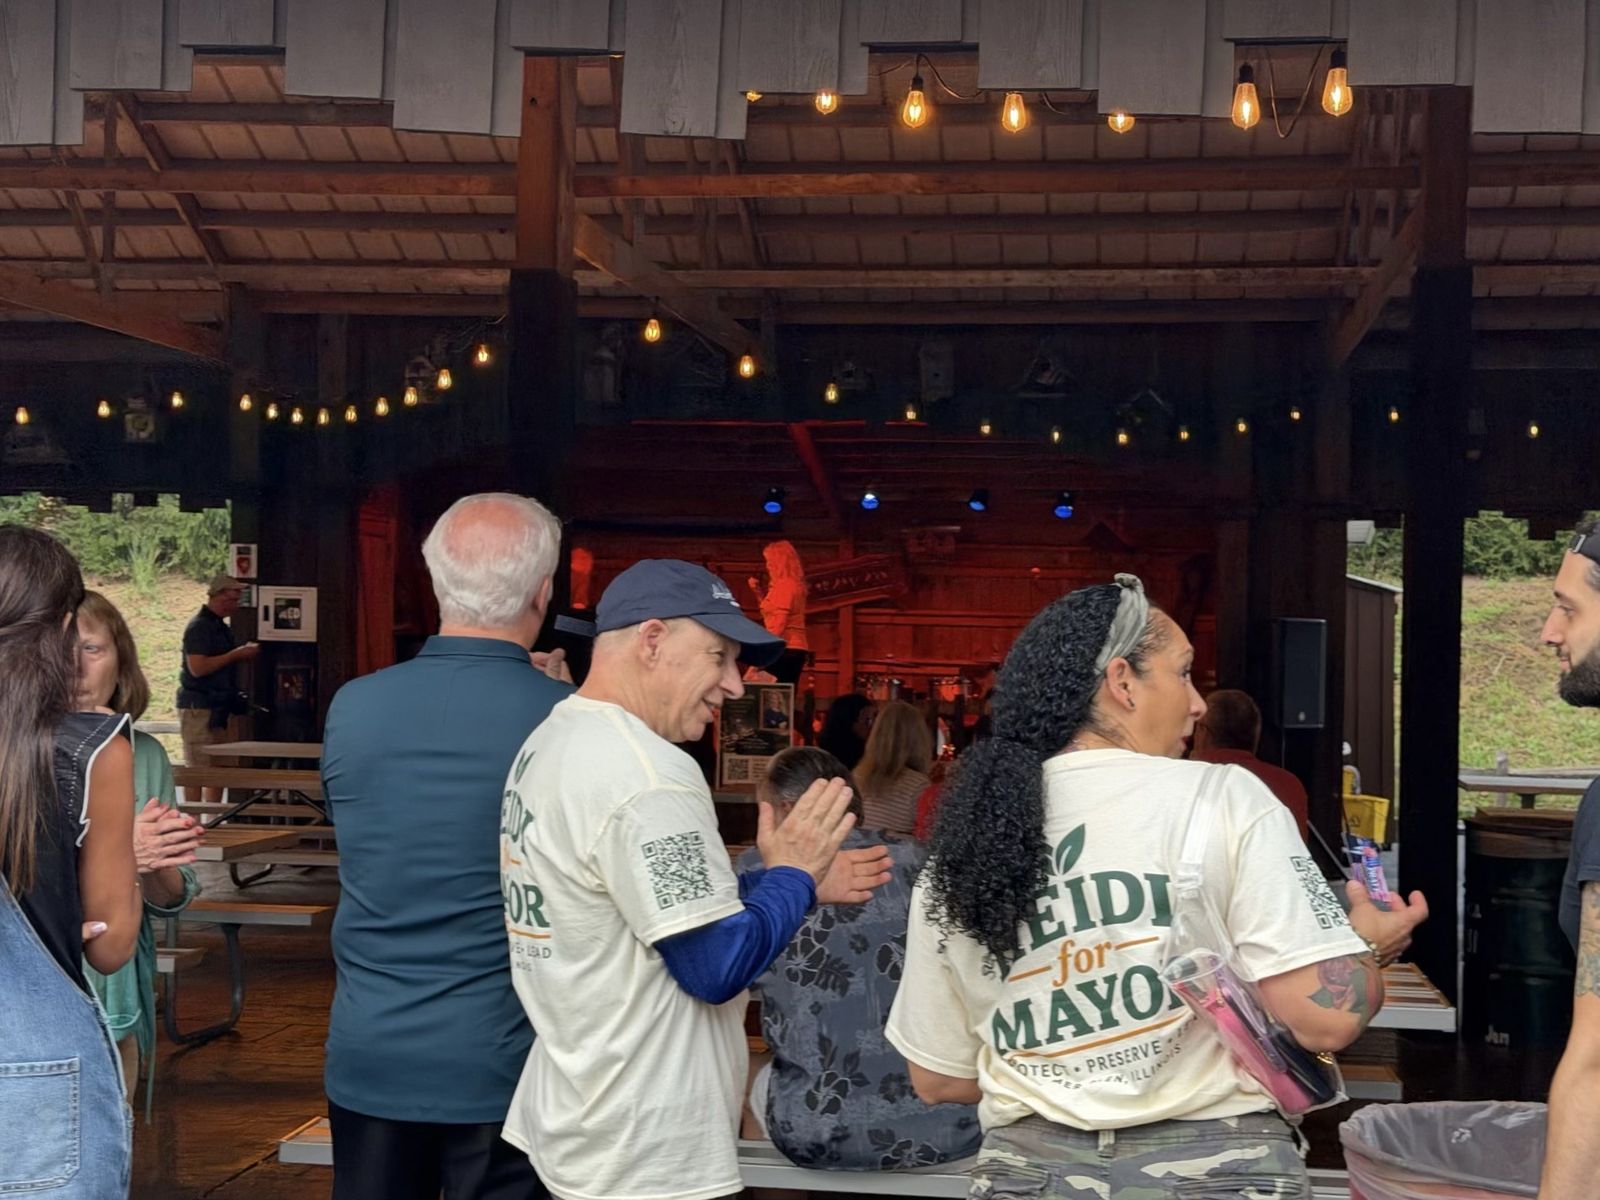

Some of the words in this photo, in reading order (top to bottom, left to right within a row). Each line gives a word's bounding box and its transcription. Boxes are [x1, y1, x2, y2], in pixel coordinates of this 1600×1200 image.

[1014, 870, 1173, 958] EIDI
[1051, 938, 1114, 988] for
[1085, 1039, 1163, 1074] PRESERVE
